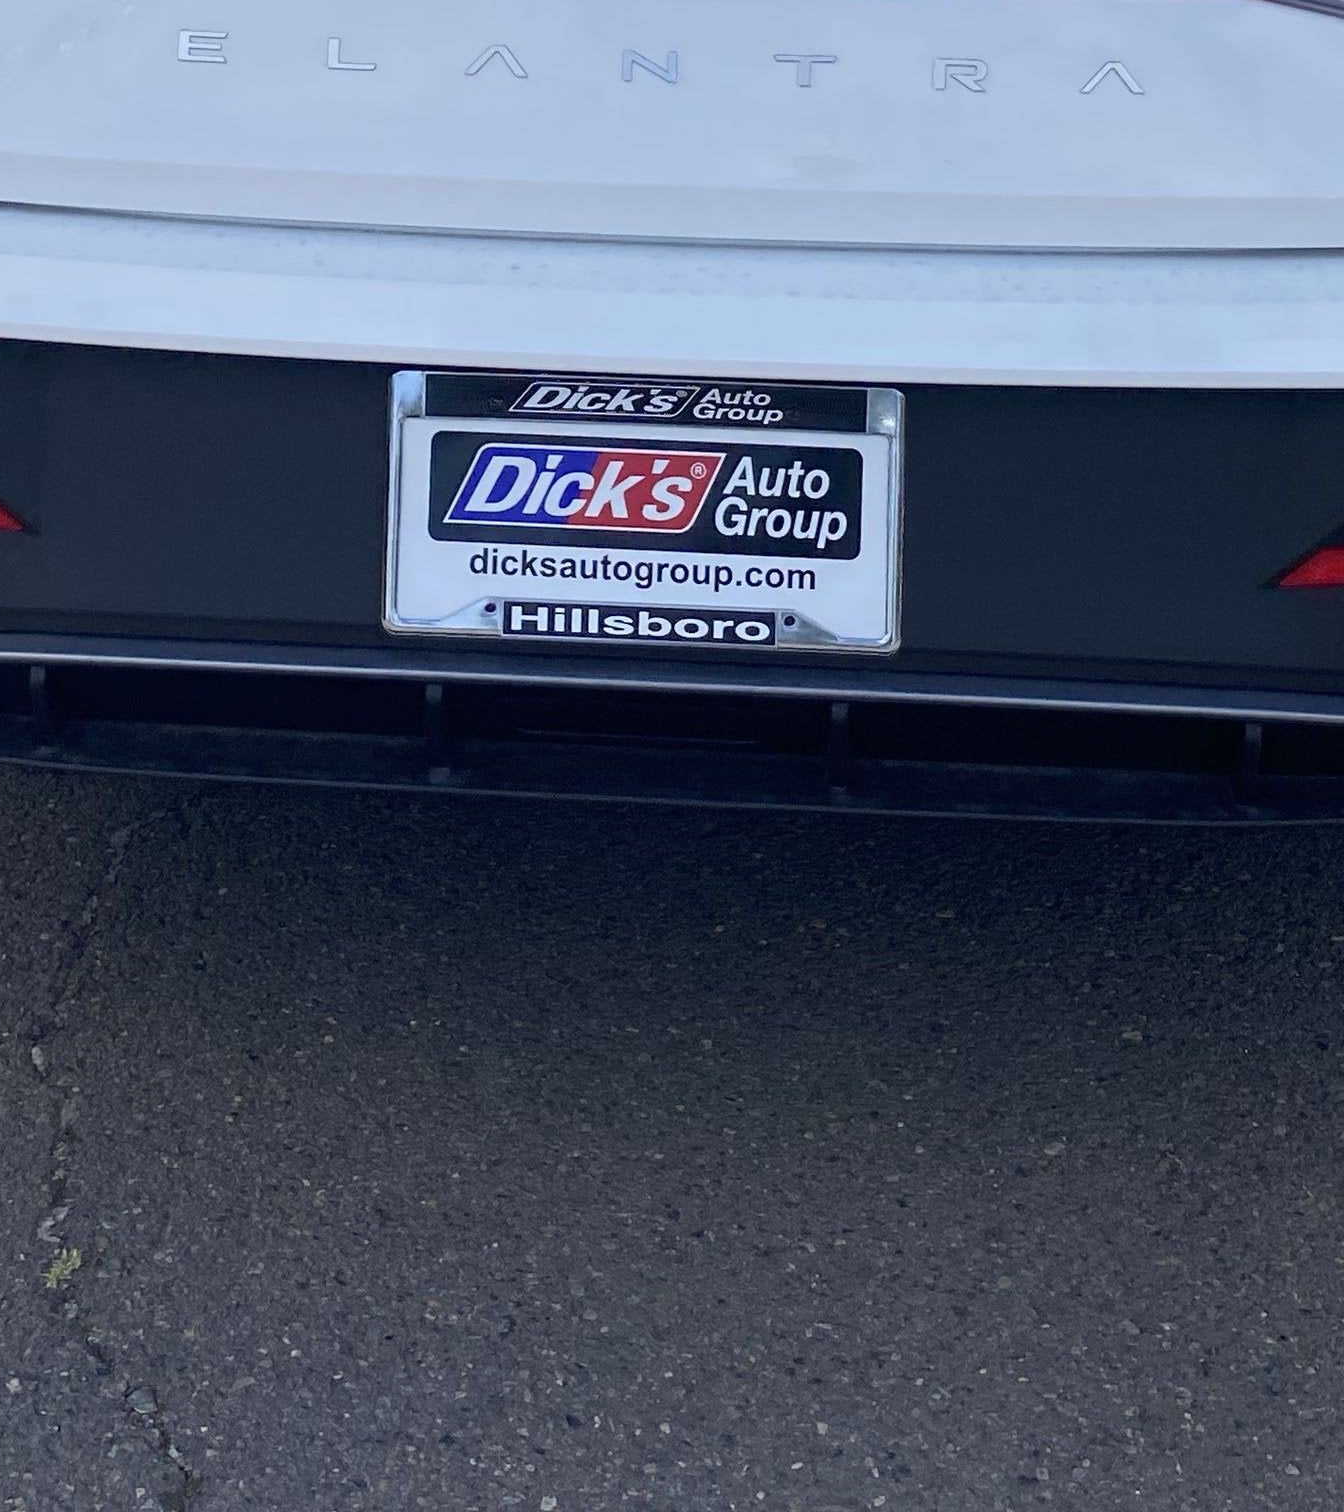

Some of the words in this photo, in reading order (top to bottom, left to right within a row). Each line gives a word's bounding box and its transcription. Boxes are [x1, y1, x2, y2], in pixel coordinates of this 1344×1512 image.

[176, 29, 1146, 95] ELANTRA
[692, 403, 784, 425] Group
[700, 388, 771, 406] Auto
[723, 456, 831, 500] Auto
[713, 496, 848, 550] Group
[468, 548, 817, 590] dicksautogroup.com
[509, 604, 772, 642] Hillsboro
